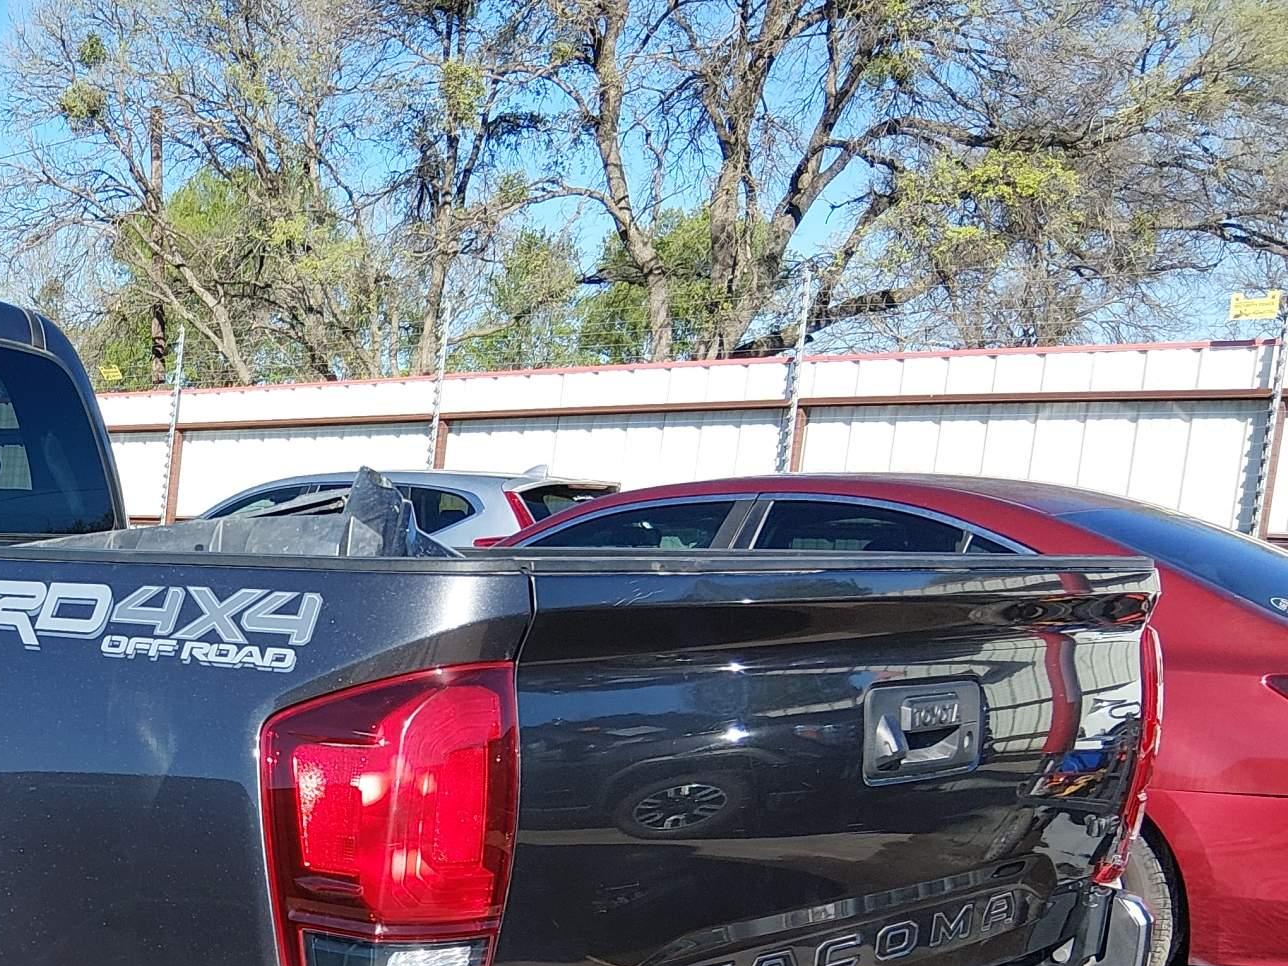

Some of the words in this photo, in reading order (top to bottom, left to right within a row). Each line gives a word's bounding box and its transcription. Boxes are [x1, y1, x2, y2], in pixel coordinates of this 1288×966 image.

[111, 586, 324, 646] 4X4
[101, 635, 179, 661] OFF
[180, 641, 297, 673] ROAD
